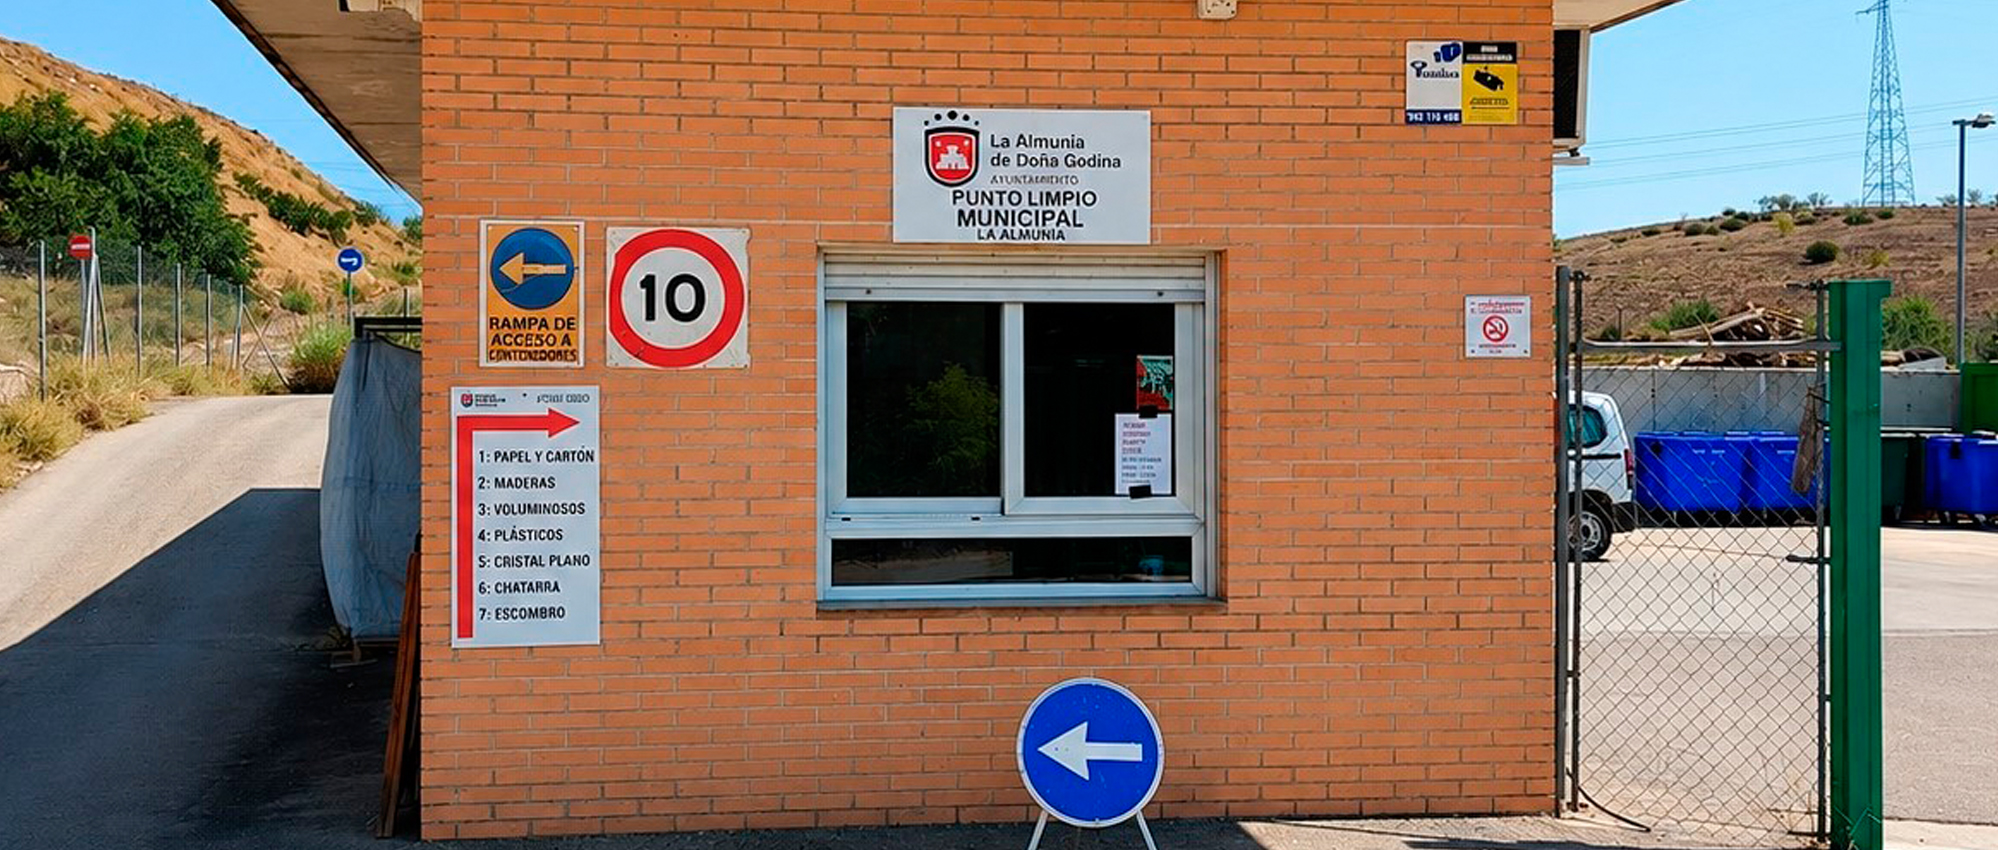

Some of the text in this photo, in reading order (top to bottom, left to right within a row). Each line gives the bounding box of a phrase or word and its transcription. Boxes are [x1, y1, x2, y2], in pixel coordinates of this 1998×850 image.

[990, 134, 1085, 149] La Almunia
[990, 153, 1121, 168] de Doña Godina
[952, 190, 1098, 207] PUNTO LIMPIO
[957, 209, 1084, 228] MUNICIPAL
[977, 229, 997, 241] LA
[639, 273, 706, 322] 10
[489, 317, 577, 331] RAMPA DE
[491, 333, 572, 347] ACCESO A
[478, 446, 595, 463] 1: PAPEL Y CARTÓN
[478, 476, 556, 489] 2: MADERAS
[478, 502, 586, 516] 3: VOLUMINOSOS
[478, 525, 564, 542] 4: PLÁSTICOS
[494, 554, 545, 568] CRISTAL
[549, 554, 591, 567] PLANO
[478, 581, 561, 594] 6: CHATARRA
[479, 606, 566, 621] 7: ESCOMBRO
